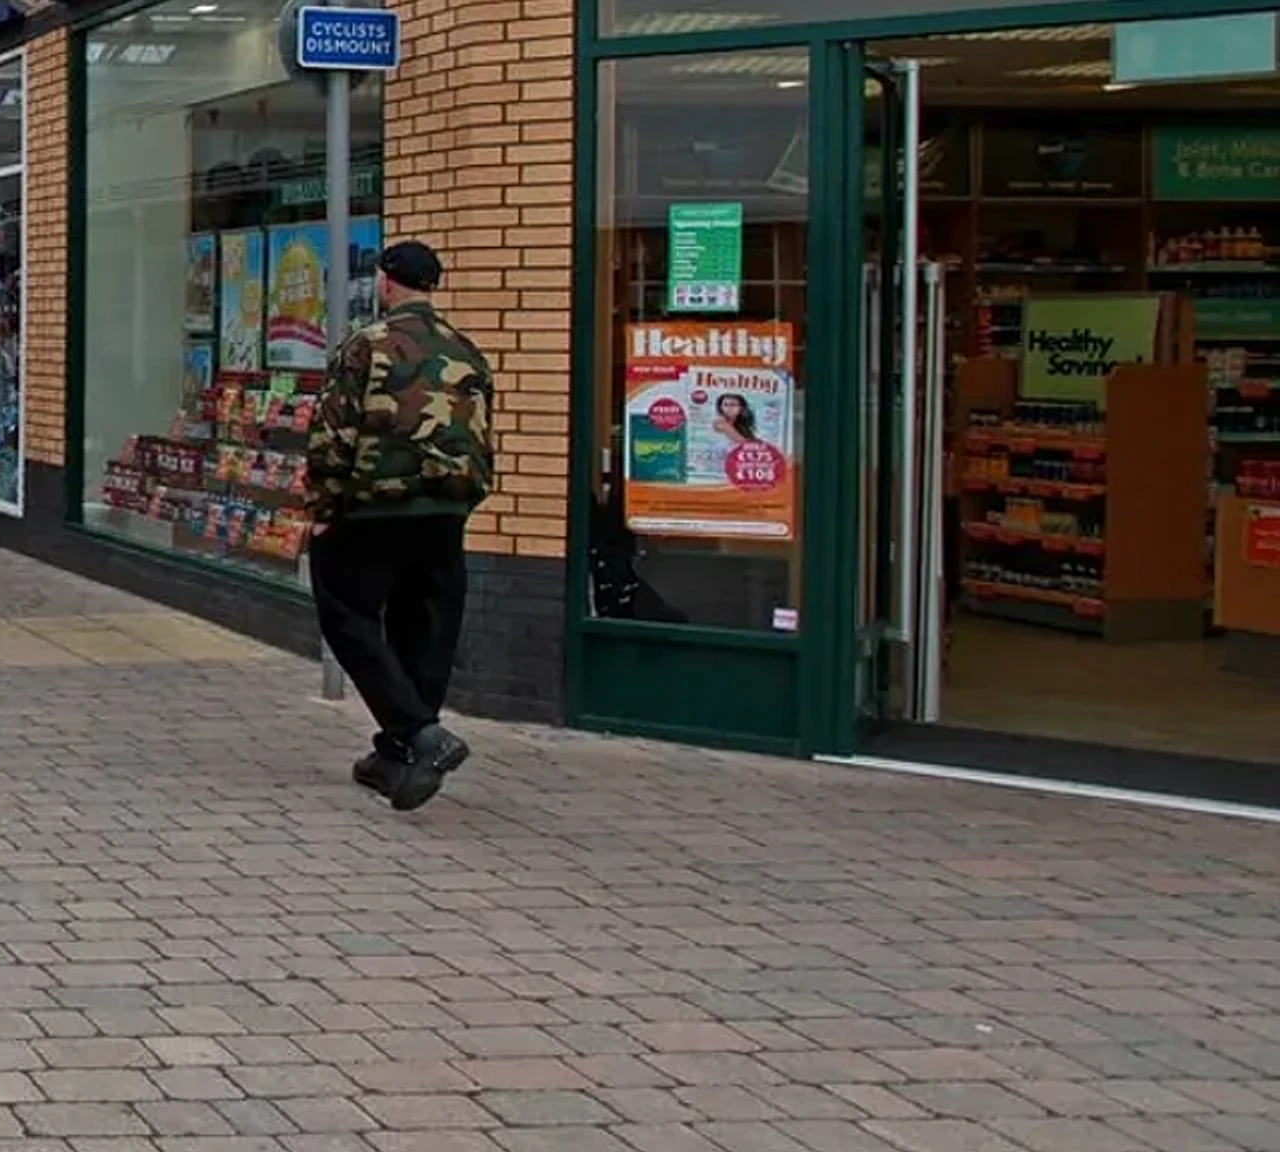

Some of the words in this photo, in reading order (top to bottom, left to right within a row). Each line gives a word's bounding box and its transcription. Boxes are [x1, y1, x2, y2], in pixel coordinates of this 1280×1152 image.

[311, 21, 387, 39] CYCLISTS
[306, 36, 391, 55] DISMOUNT
[633, 328, 787, 366] Healthy
[1028, 328, 1115, 359] Healthy
[695, 371, 779, 395] Healthy
